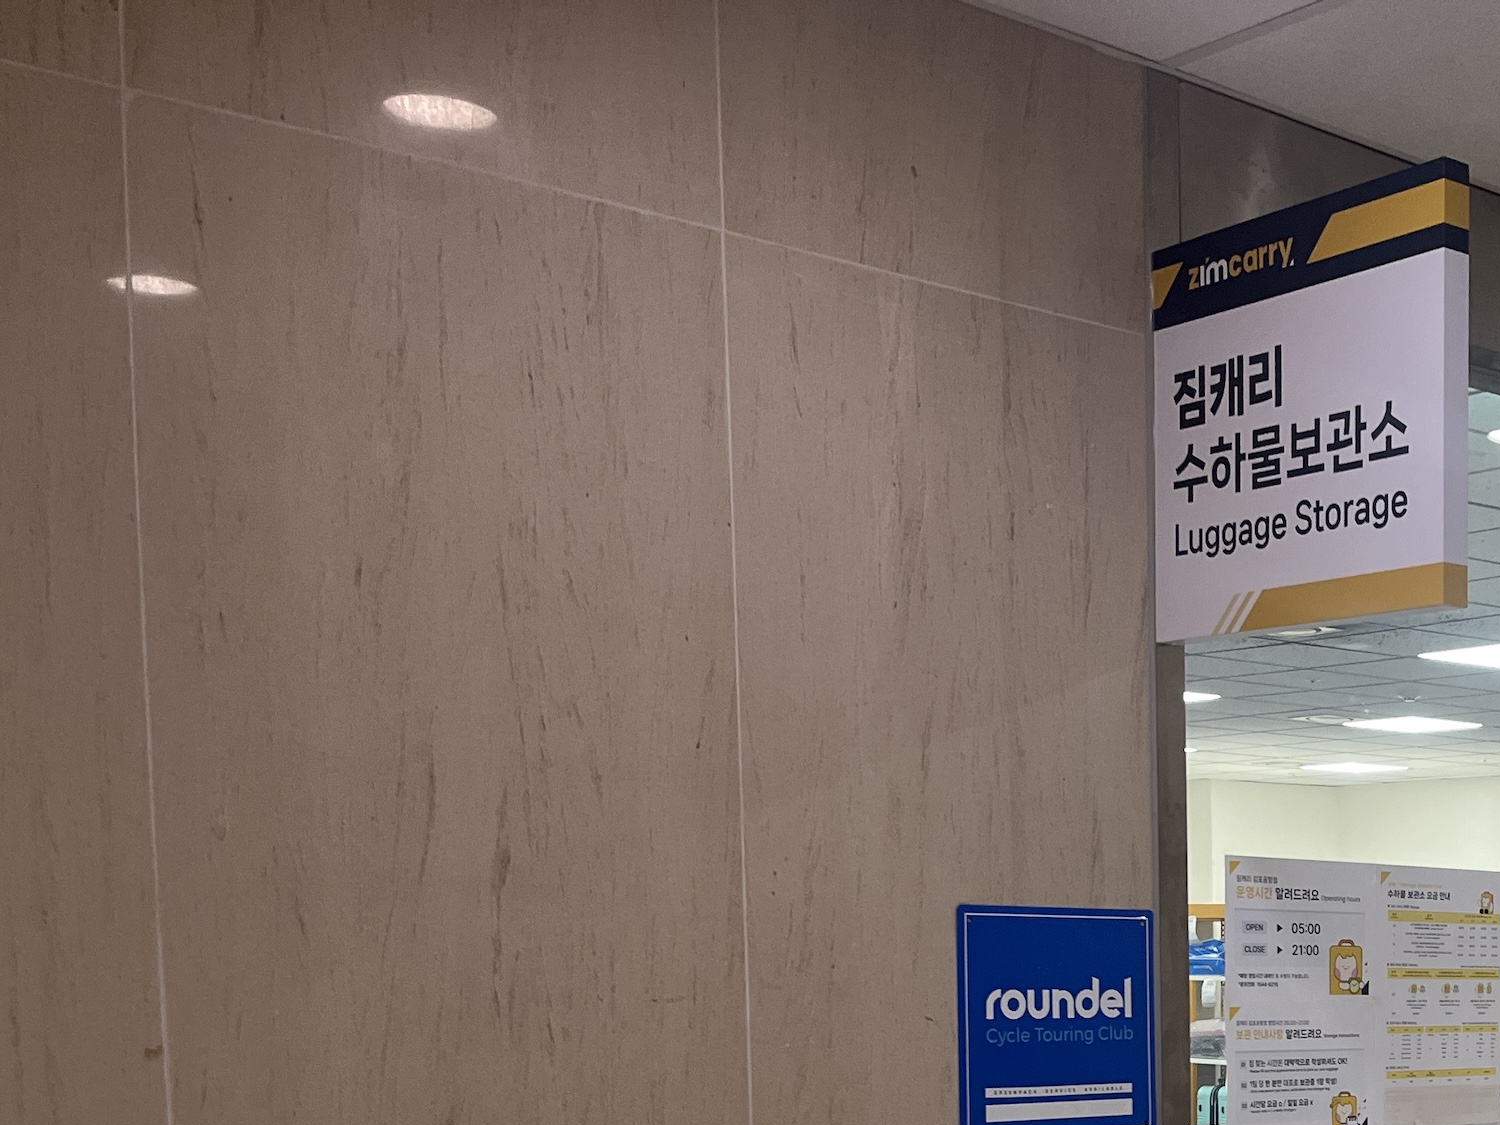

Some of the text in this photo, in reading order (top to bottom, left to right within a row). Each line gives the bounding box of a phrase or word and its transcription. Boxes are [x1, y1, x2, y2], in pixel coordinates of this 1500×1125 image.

[1173, 345, 1283, 430] 짐캐리
[1173, 401, 1409, 503] 수하물보관소
[1174, 491, 1408, 558] Luggage Storage
[1236, 886, 1273, 899] 운영시간
[1275, 888, 1319, 900] 알려드려요
[1388, 890, 1451, 900] 수하물 보관소 요금 안내
[1245, 922, 1321, 935] OPEN 05:00
[1244, 944, 1320, 956] CLOSE 21:00
[985, 976, 1133, 1020] roundel
[986, 1025, 1134, 1047] Cycle Touring Club
[1236, 1030, 1251, 1040] 보관
[1253, 1029, 1284, 1040] 안내사항
[1285, 1029, 1322, 1039] 알려드려요
